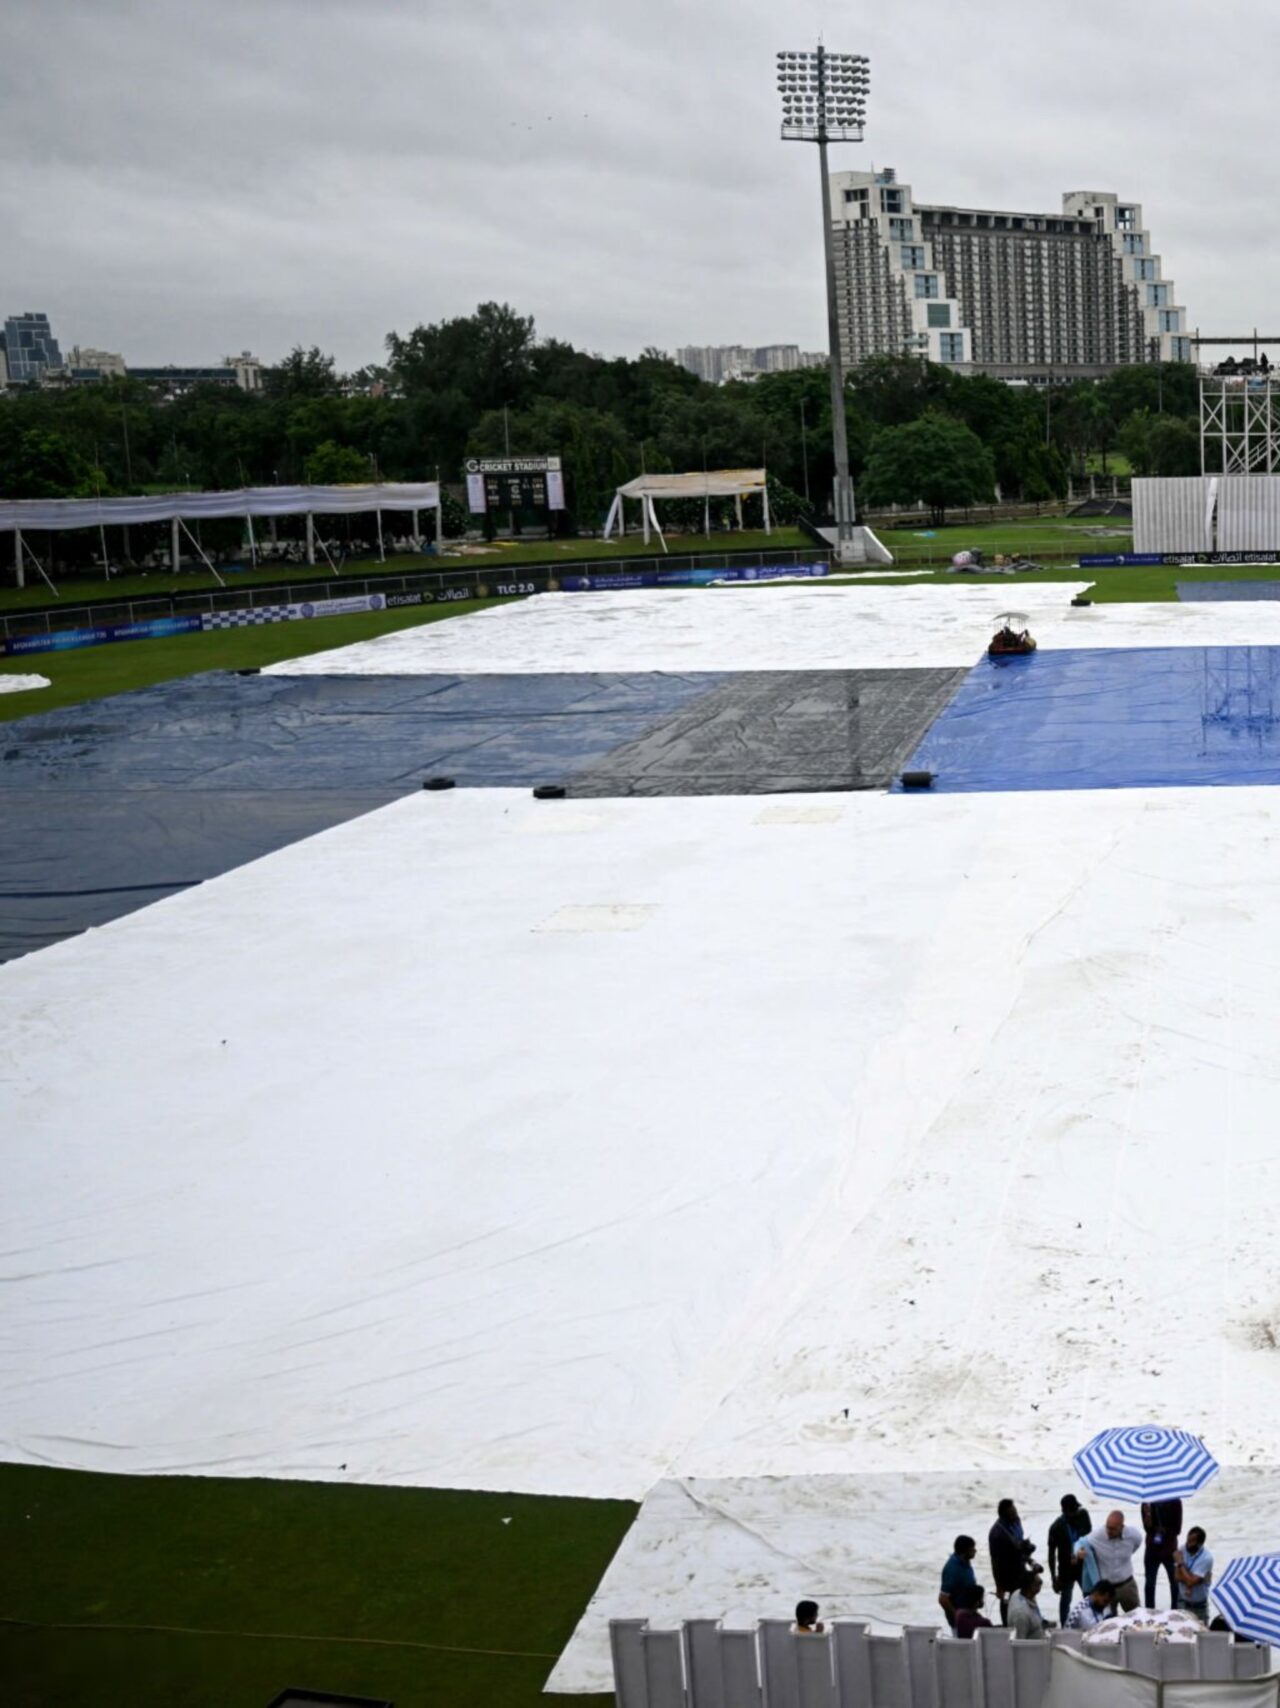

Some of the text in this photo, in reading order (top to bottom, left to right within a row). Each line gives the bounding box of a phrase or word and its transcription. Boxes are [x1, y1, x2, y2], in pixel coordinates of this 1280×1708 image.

[480, 463, 512, 472] CRICKET
[514, 462, 547, 472] STADIUM
[1163, 555, 1195, 564] etisalat
[1211, 552, 1242, 562] اتصالات
[1245, 552, 1276, 561] etisalat
[497, 582, 535, 595] TLC 2.0
[387, 587, 469, 606] etisalat اتصالات
